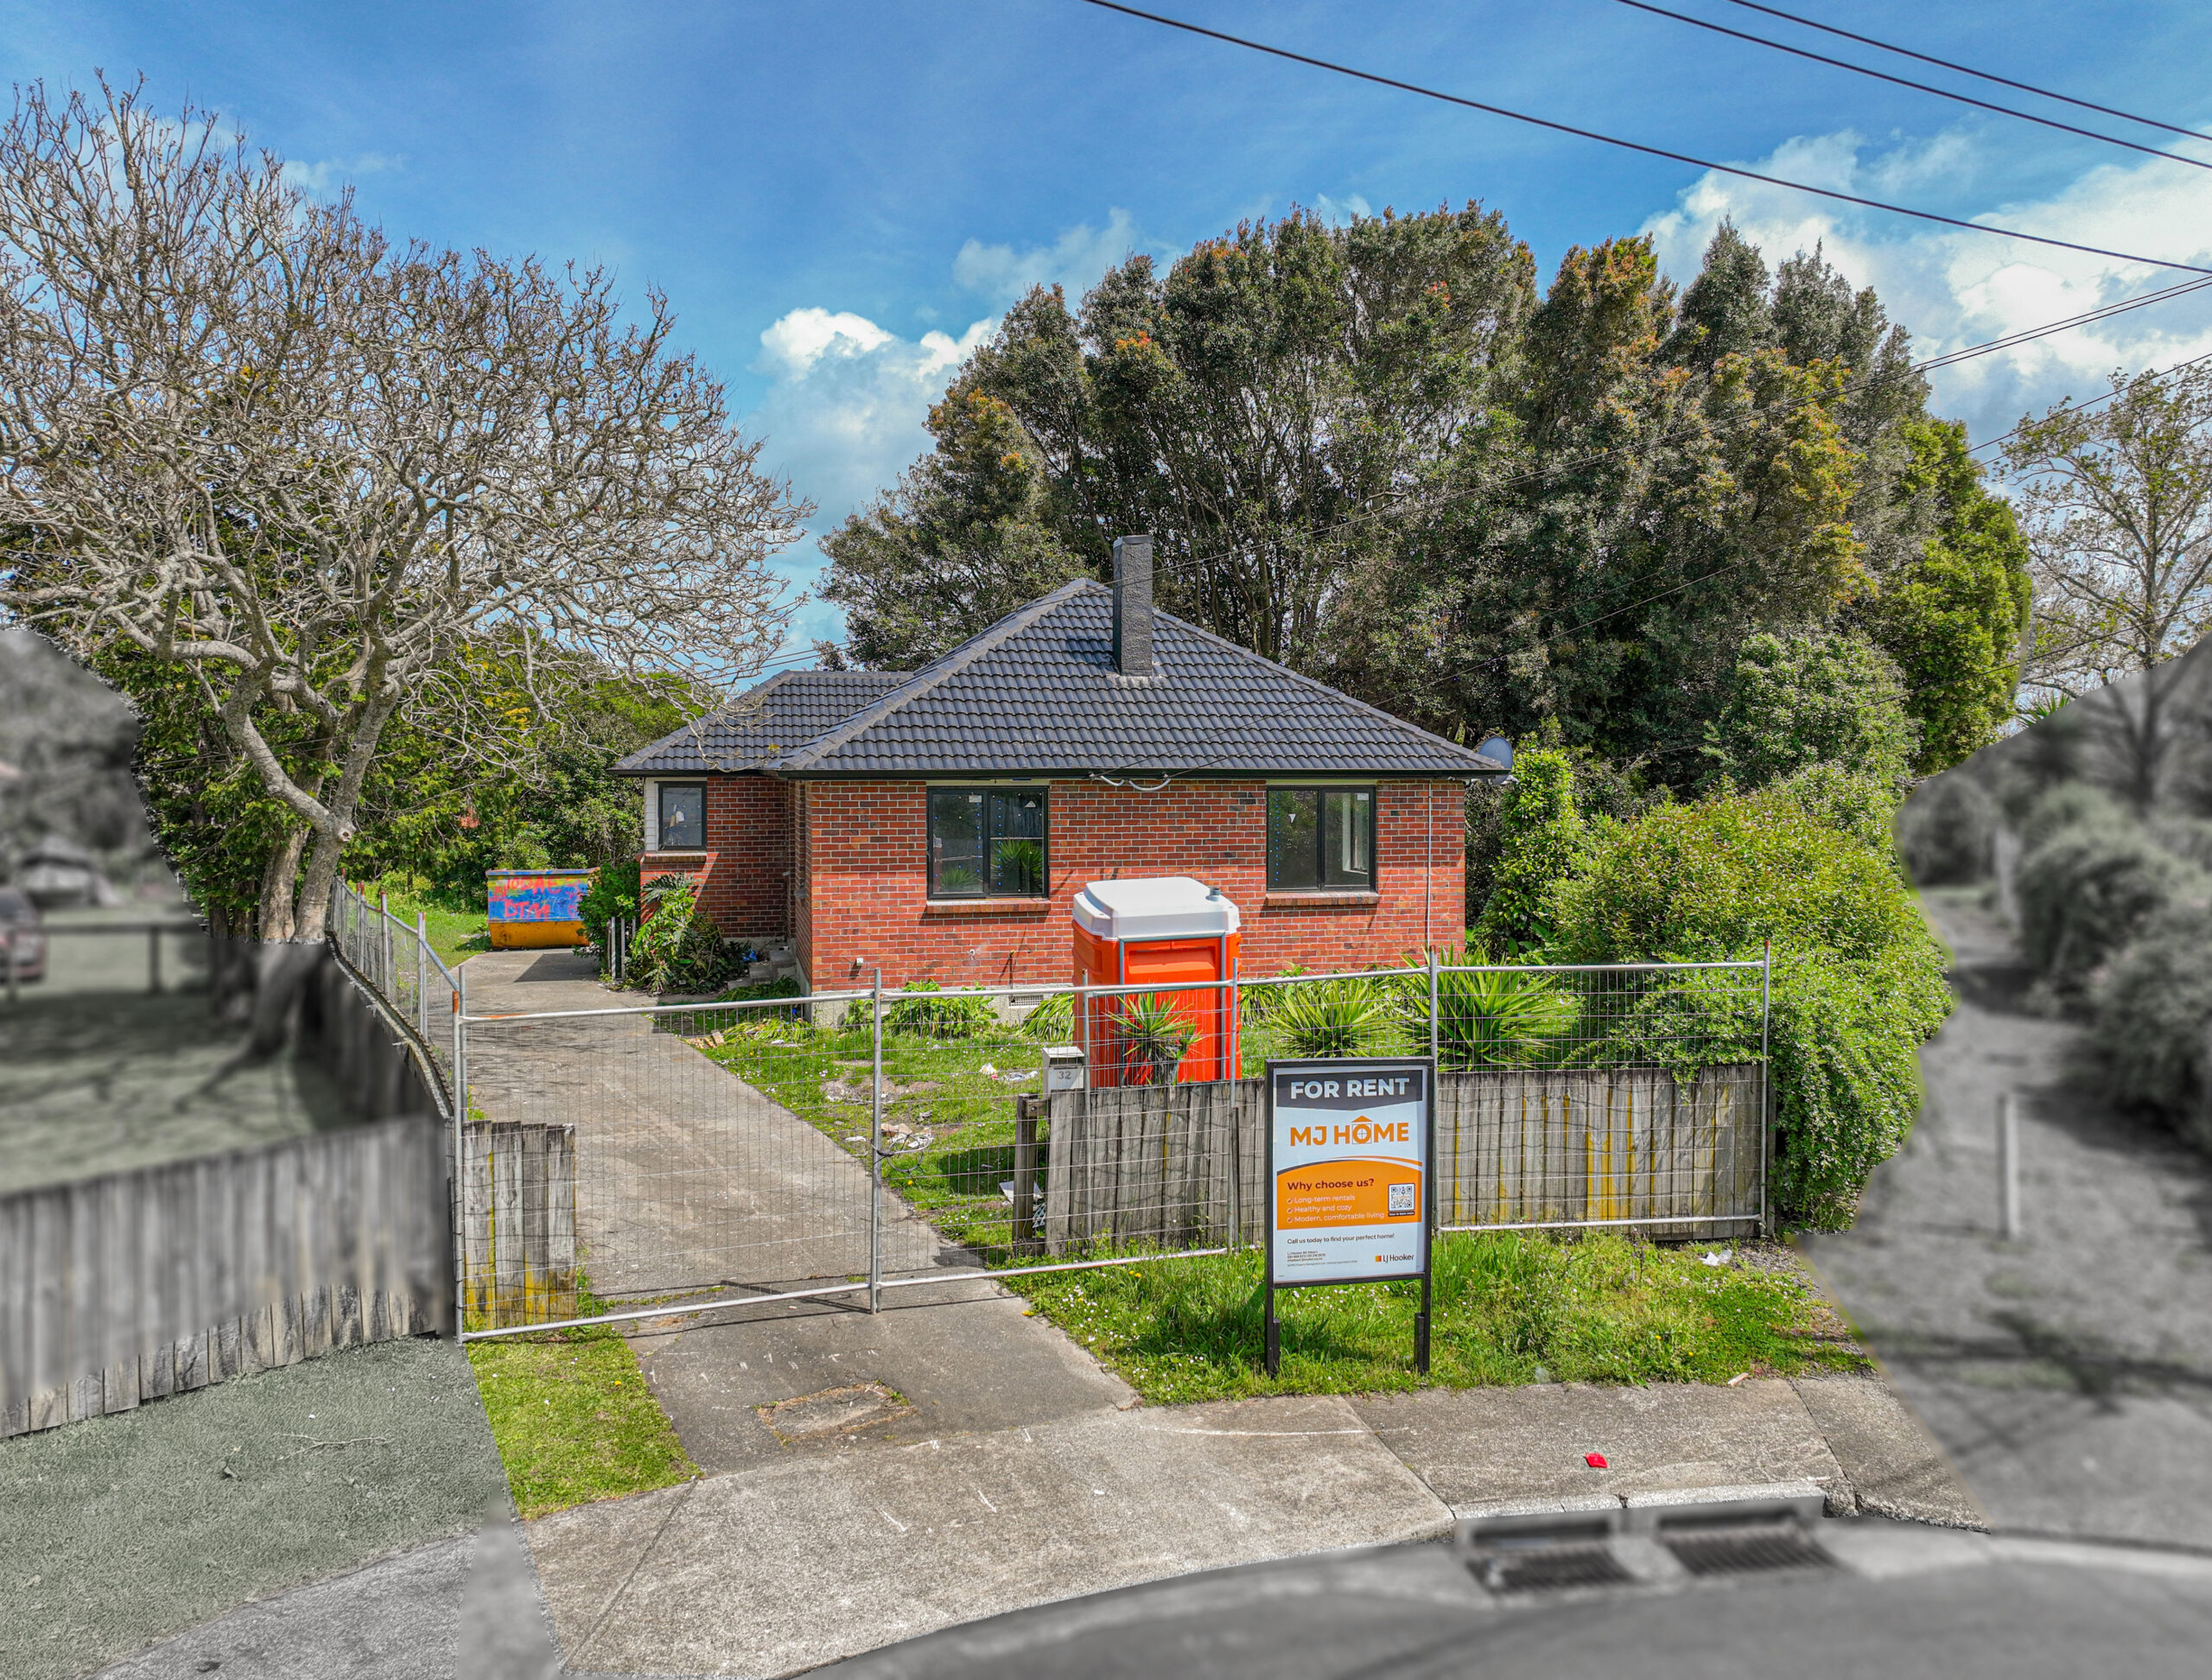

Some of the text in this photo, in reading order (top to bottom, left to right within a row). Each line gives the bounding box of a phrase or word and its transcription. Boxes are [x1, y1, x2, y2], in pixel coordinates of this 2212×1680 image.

[1058, 1071, 1071, 1079] 32
[1290, 1078, 1410, 1099] FOR RENT
[1290, 1120, 1409, 1147] MJ HOME
[1287, 1178, 1375, 1192] Why choose us?
[1294, 1195, 1331, 1204] Long-term
[1294, 1205, 1321, 1213] Healthy
[1324, 1212, 1365, 1221] comfortable
[1366, 1211, 1385, 1219] living
[1382, 1253, 1414, 1263] LJ Hooker
